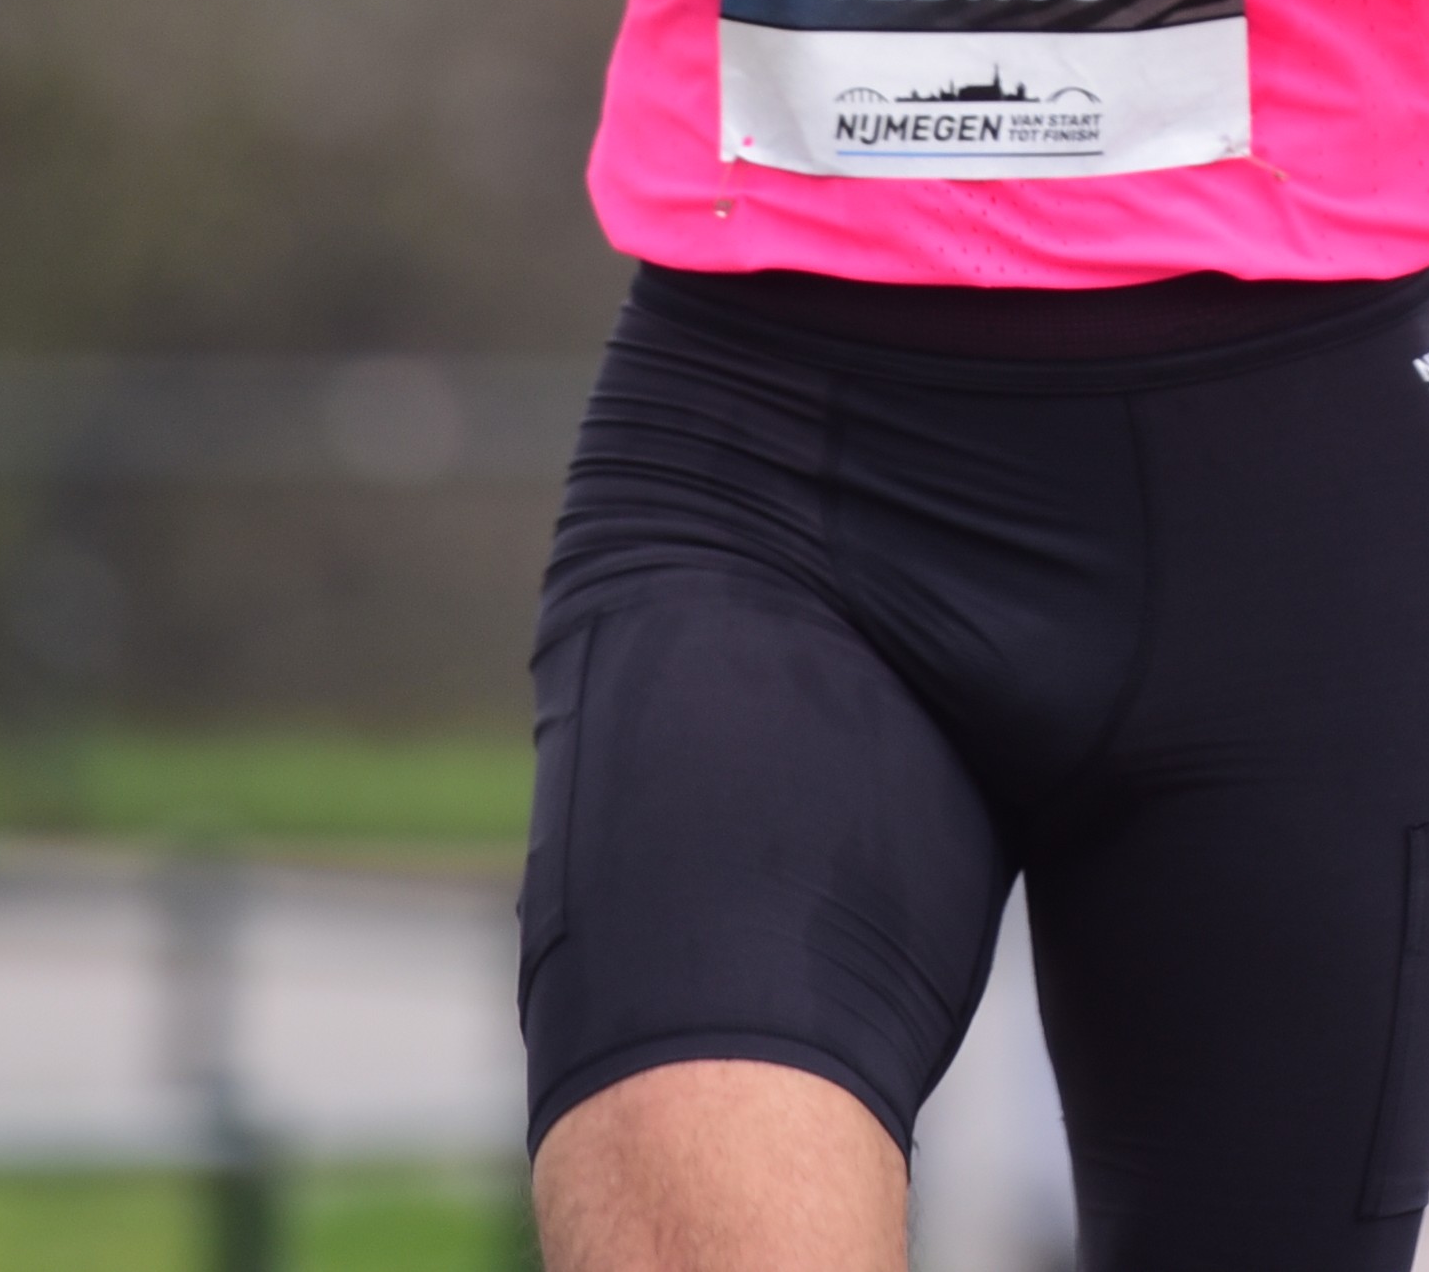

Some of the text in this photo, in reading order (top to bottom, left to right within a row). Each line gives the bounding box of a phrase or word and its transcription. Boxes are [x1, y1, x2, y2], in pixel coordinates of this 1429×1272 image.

[835, 113, 1103, 145] NIJMEGEN VAN START
[1008, 128, 1100, 142] TOT FINISH
